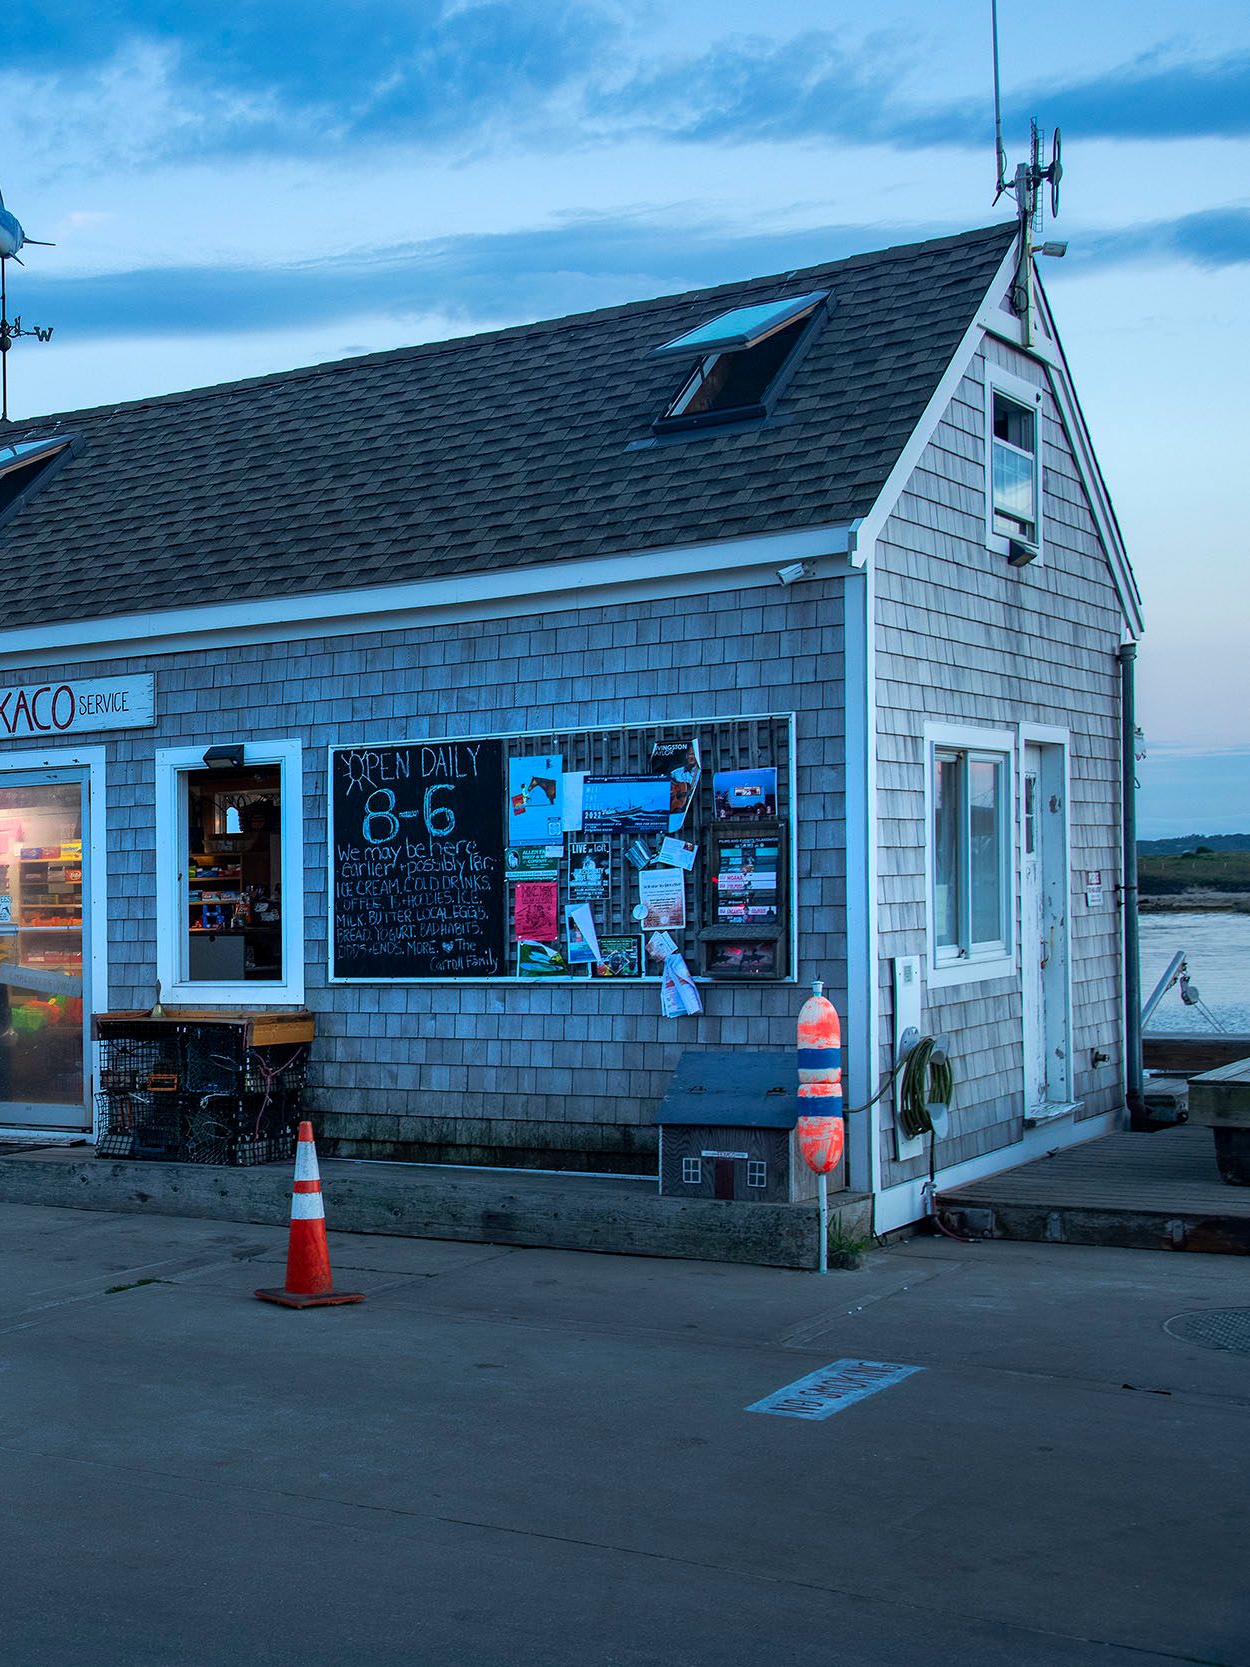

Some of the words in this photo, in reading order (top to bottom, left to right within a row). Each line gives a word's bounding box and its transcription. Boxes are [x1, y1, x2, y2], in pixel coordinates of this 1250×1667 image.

[34, 326, 54, 342] W
[78, 691, 129, 716] SERVICE
[348, 750, 410, 781] OPEN
[421, 744, 481, 777] DAILY
[363, 784, 455, 844] 8-6
[337, 843, 360, 861] We
[364, 845, 401, 867] may
[406, 836, 426, 858] be
[430, 836, 478, 857] here
[572, 844, 587, 854] LIVE
[342, 860, 392, 877] earlier
[336, 882, 353, 898] ICE
[356, 879, 403, 896] CREAM.
[404, 876, 440, 892] COLD
[374, 925, 417, 941] YOGURT.
[407, 940, 439, 957] MORE.
[455, 938, 477, 951] The
[430, 956, 464, 973] Carroll
[467, 948, 499, 974] Family
[768, 1398, 825, 1415] NO
[797, 1361, 904, 1400] SMOKING
